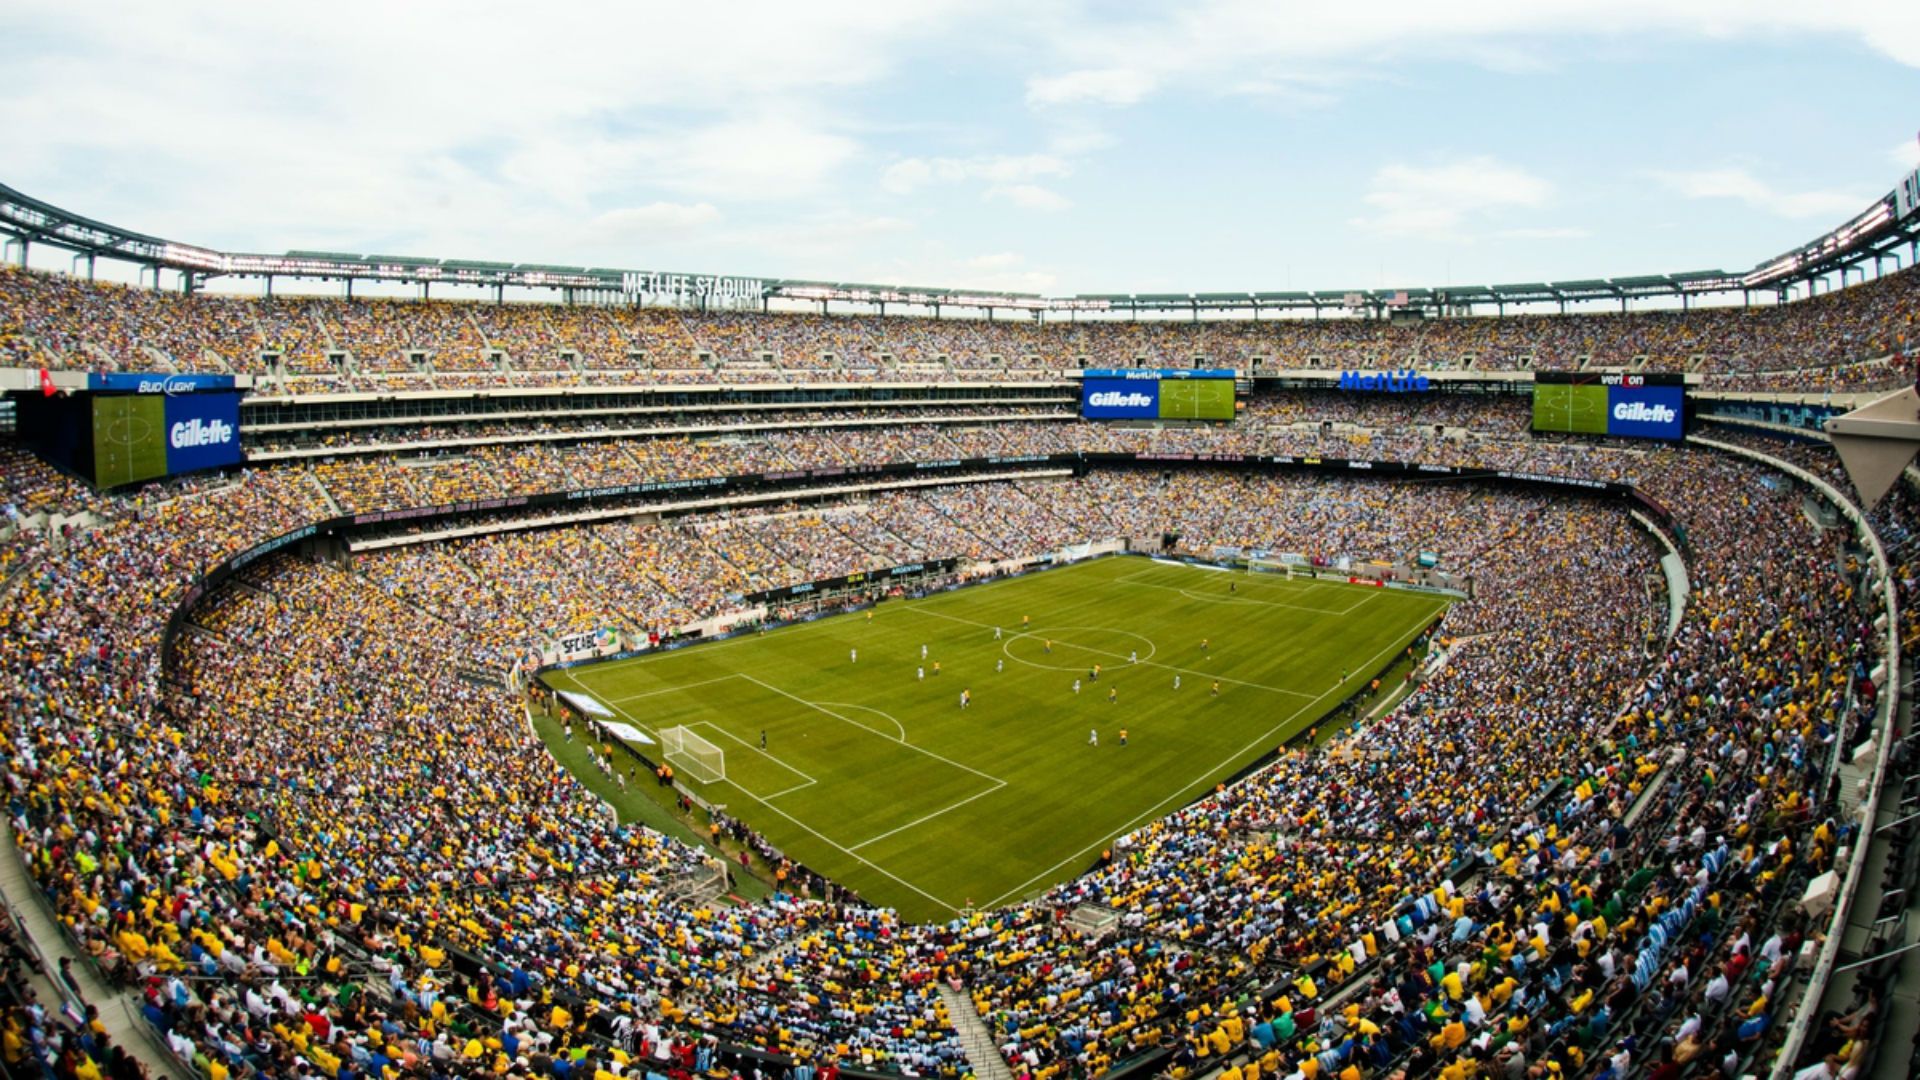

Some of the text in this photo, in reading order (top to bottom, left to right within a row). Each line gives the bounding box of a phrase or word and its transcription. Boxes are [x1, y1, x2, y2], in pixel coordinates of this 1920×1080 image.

[623, 272, 763, 299] METLIFE STADIUM
[1126, 370, 1162, 380] MetLife
[1340, 368, 1429, 392] MetLife
[138, 380, 197, 393] BUD LIGHT
[1089, 391, 1152, 407] Gillette
[1614, 402, 1675, 423] Gillette
[171, 418, 232, 448] Gillette
[891, 564, 924, 575] ARGENTINA
